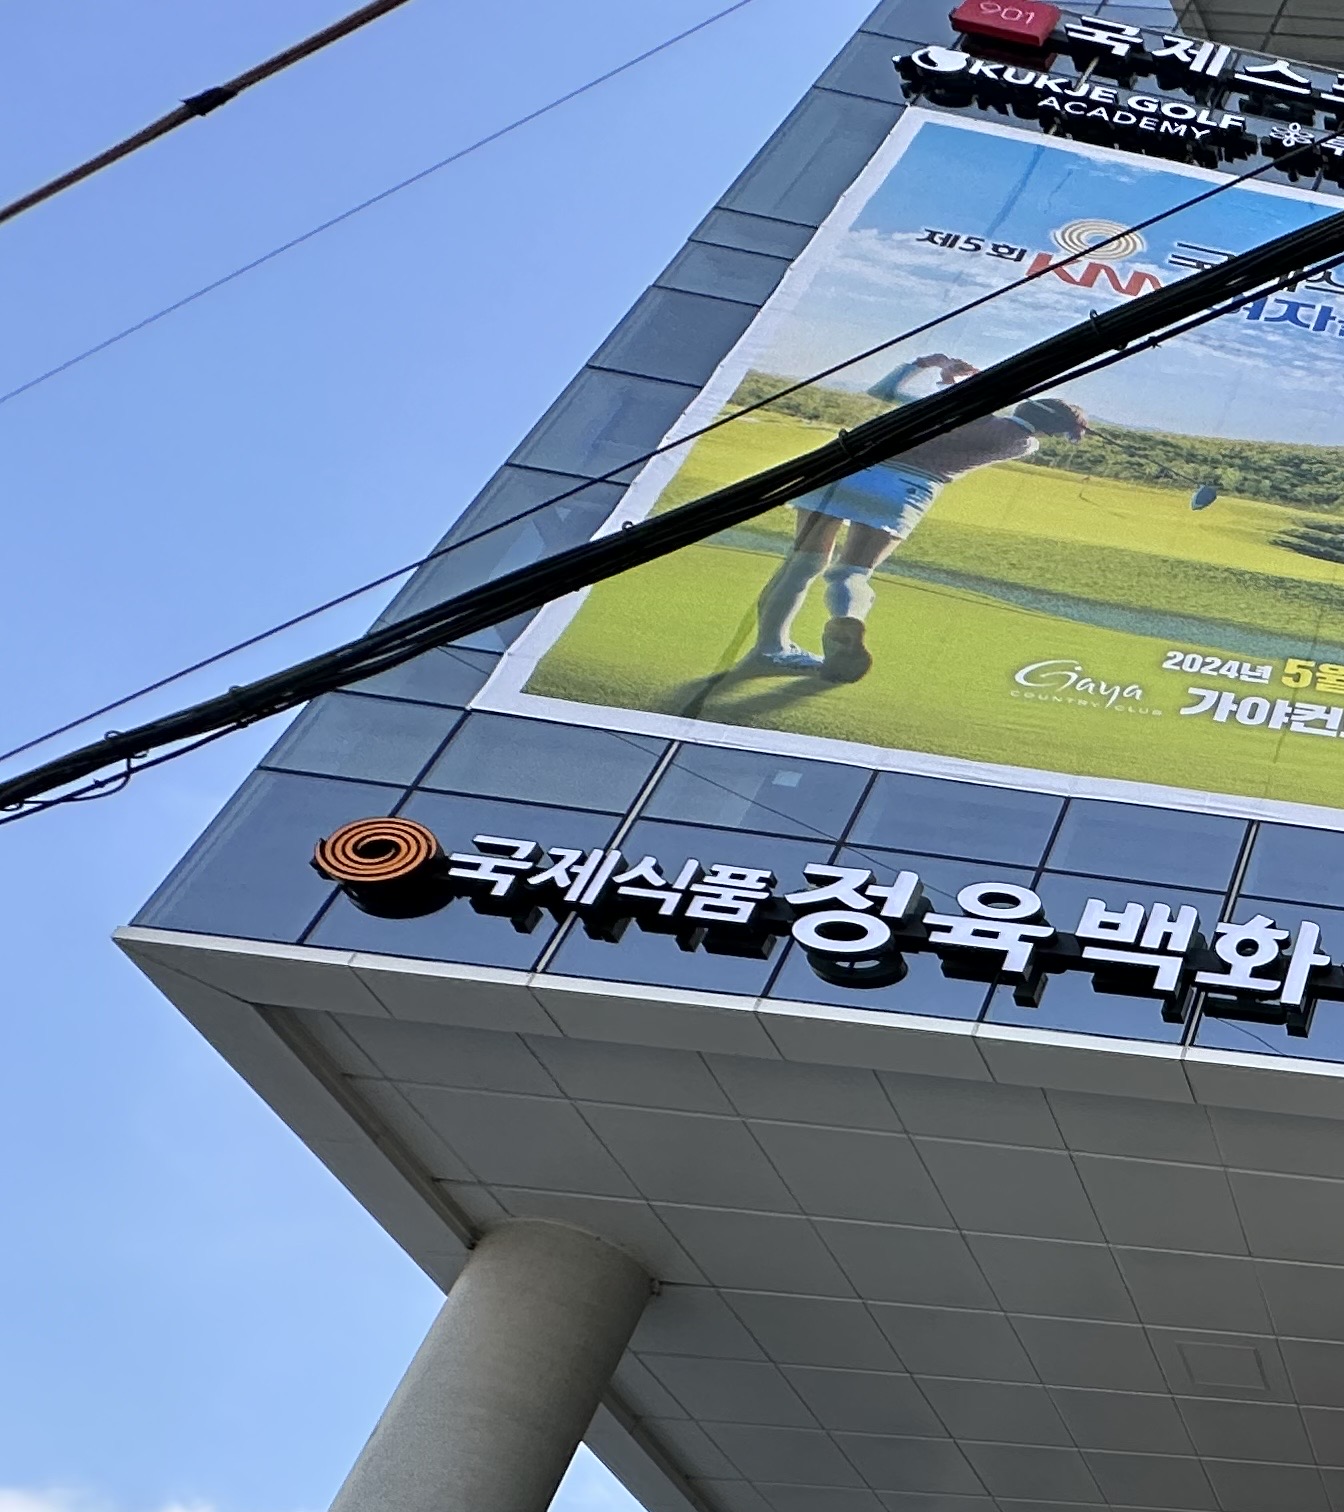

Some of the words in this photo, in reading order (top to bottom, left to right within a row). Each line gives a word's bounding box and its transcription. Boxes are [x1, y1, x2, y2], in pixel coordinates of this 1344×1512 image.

[979, 1, 1036, 25] 901
[969, 60, 1118, 104] KUKJE
[1127, 95, 1246, 130] GOLF
[1038, 97, 1211, 140] ACADEMY
[916, 228, 1027, 262] 제5회
[1014, 659, 1144, 709] Gaya
[1162, 650, 1273, 684] 2024년
[1010, 689, 1098, 708] COUNTRY
[1114, 703, 1162, 717] CLUB
[448, 832, 780, 925] 국제식품
